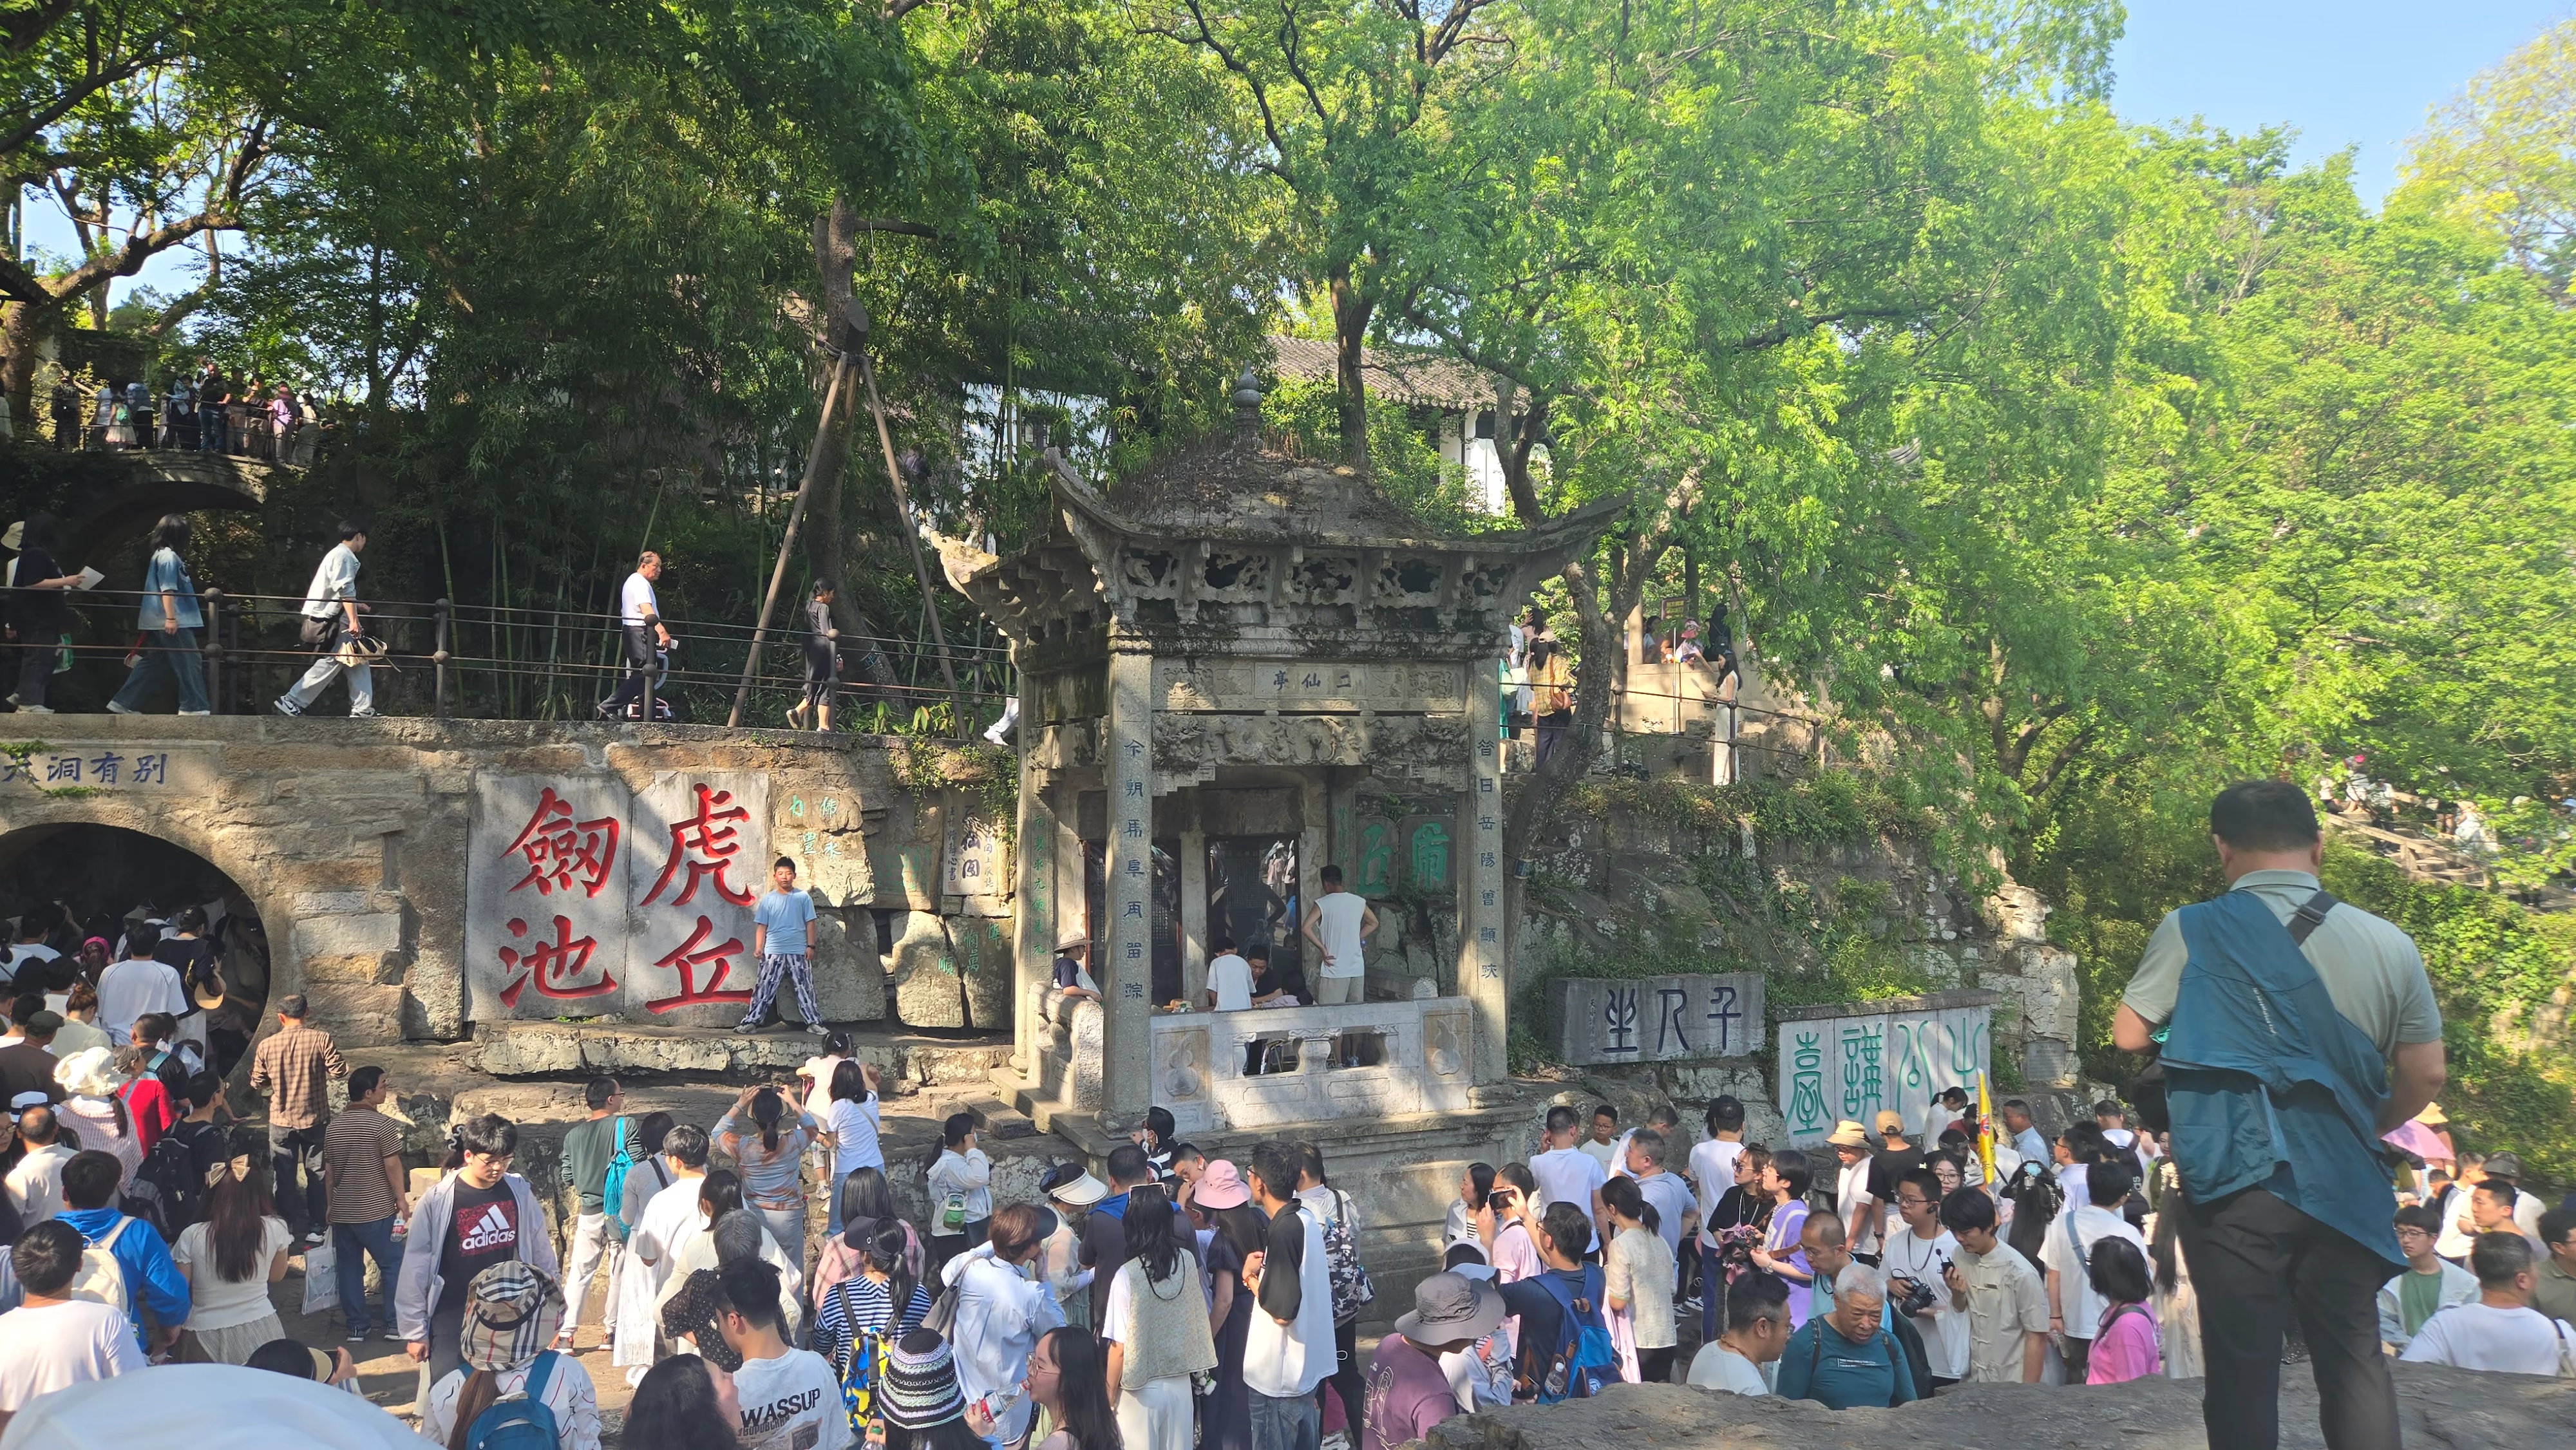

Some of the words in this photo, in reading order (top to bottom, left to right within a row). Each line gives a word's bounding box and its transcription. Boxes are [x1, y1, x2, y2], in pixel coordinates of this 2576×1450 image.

[1273, 670, 1352, 691] 二仙亭
[639, 782, 756, 1015] 虎丘
[462, 1229, 516, 1250] adidas
[740, 1388, 820, 1428] WASSUP
